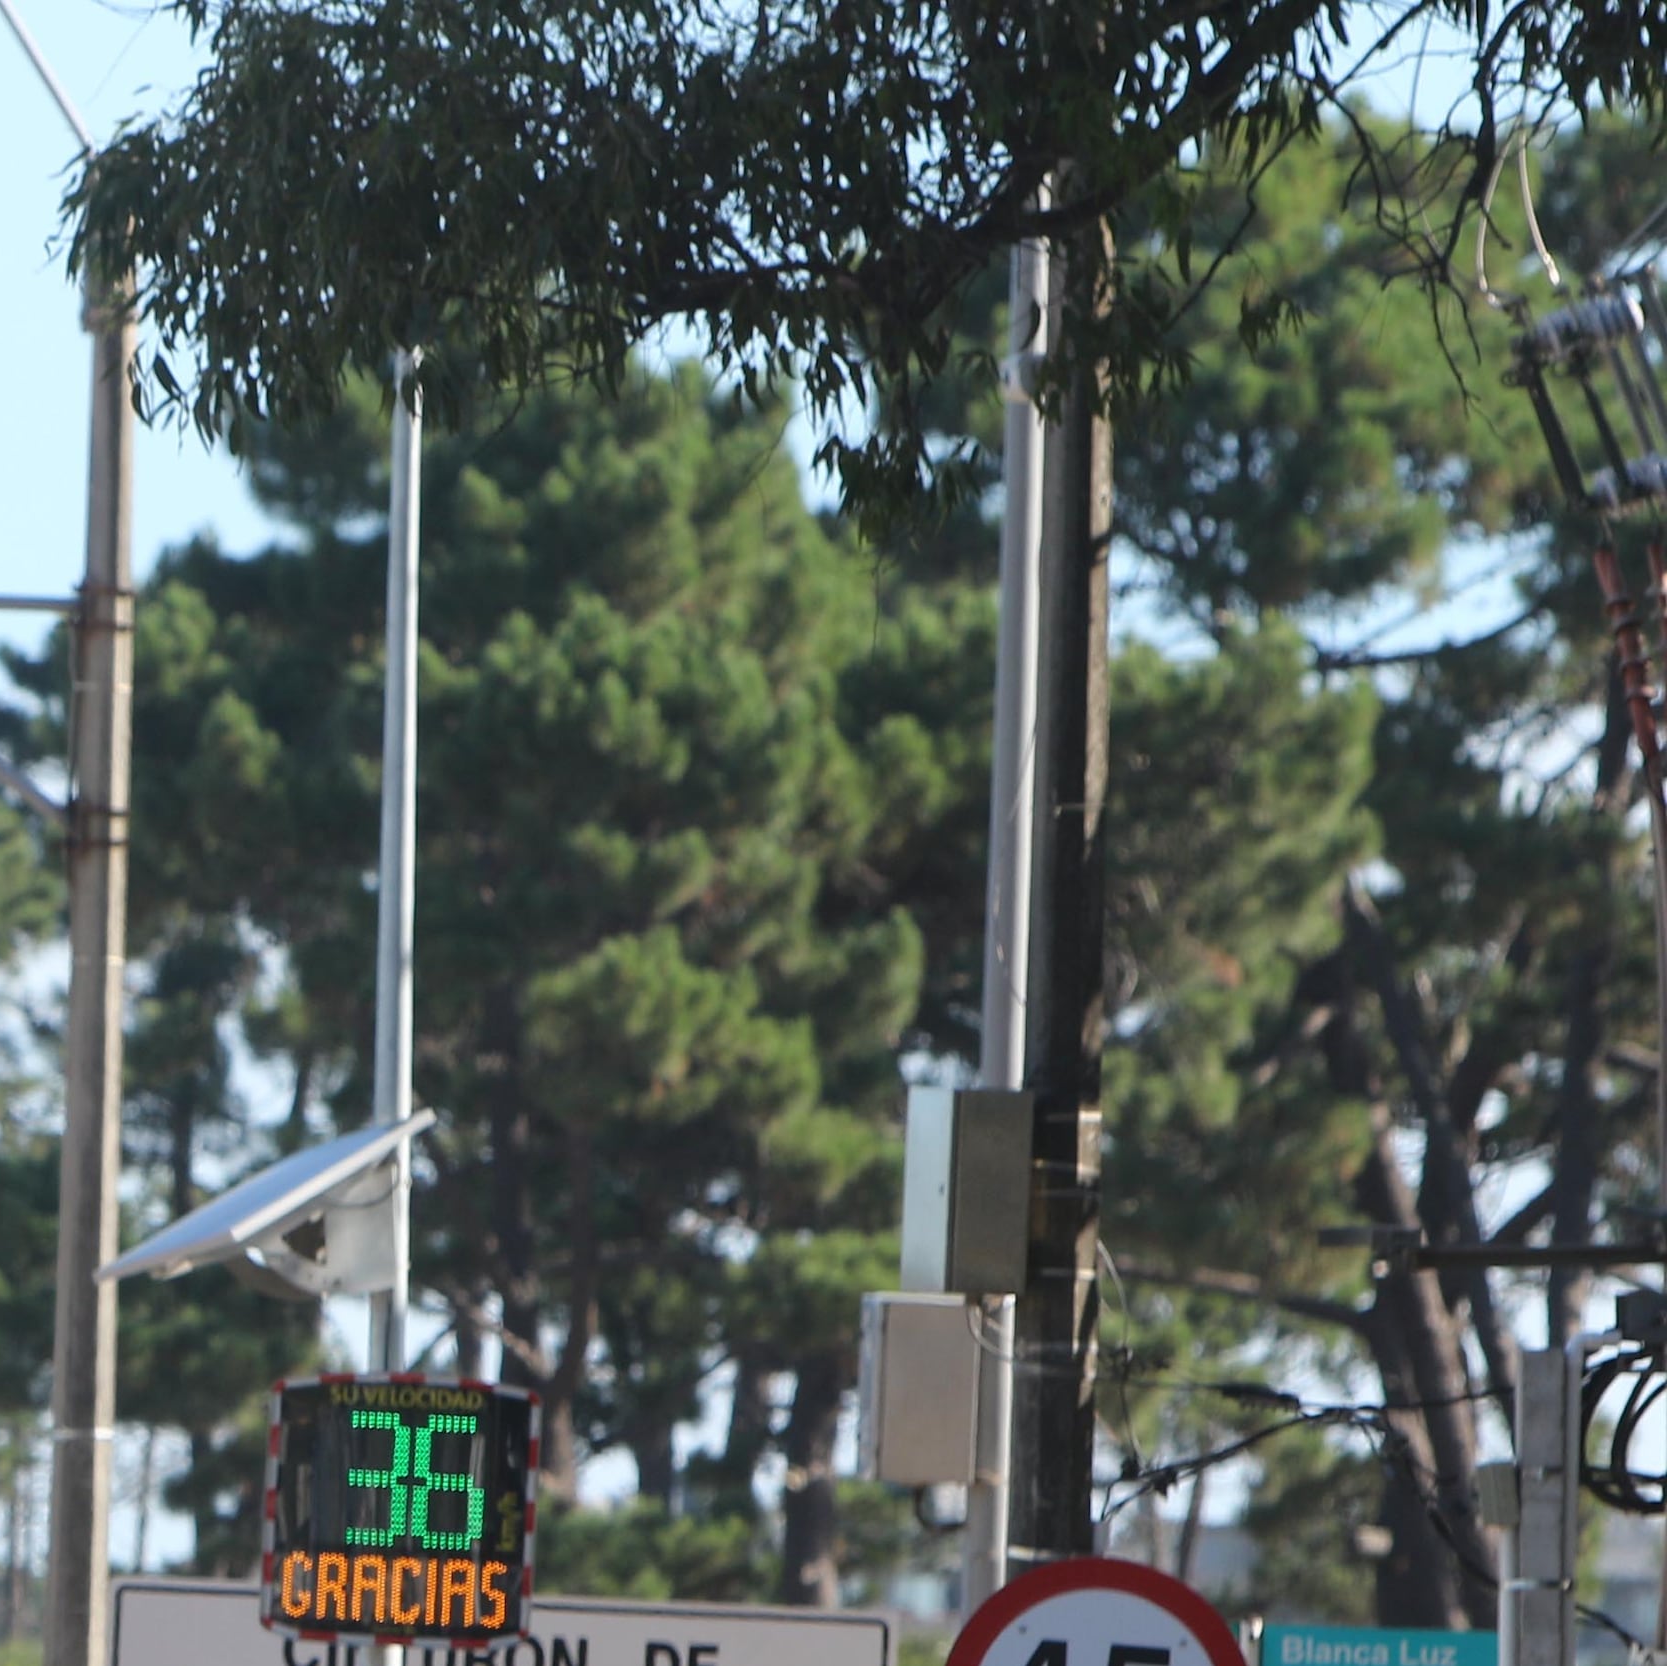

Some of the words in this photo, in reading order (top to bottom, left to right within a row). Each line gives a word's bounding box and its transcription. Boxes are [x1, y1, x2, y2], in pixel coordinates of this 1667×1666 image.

[330, 1384, 354, 1405] SU
[366, 1386, 483, 1408] VELOCIDAD
[345, 1410, 485, 1550] 36
[281, 1550, 508, 1630] GRACIAS
[1281, 1634, 1390, 1666] Blanca
